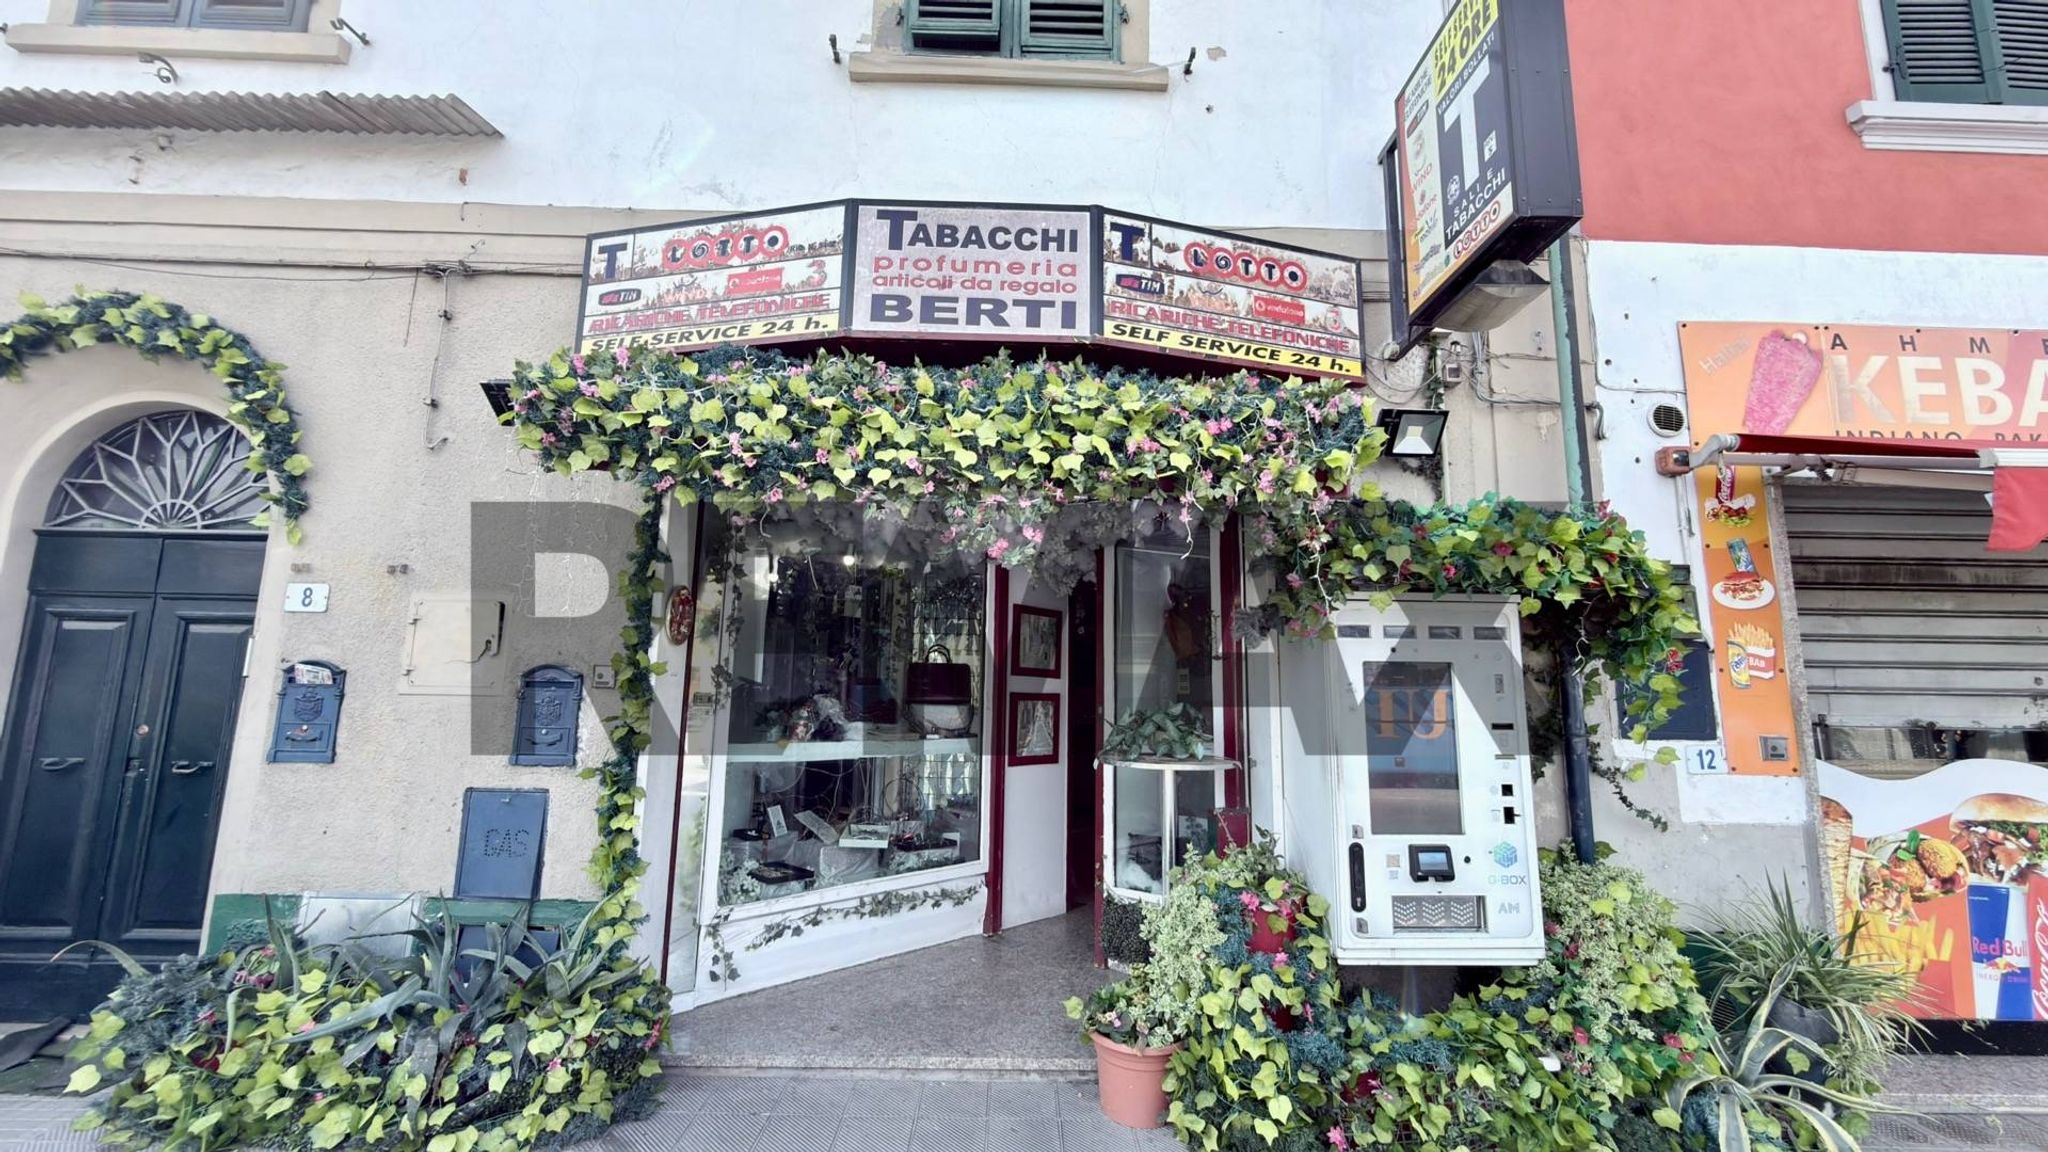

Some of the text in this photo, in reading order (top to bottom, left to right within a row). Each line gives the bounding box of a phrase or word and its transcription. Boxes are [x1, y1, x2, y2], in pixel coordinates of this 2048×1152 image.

[1436, 0, 1491, 97] 24 ORE
[1437, 32, 1494, 114] VALORI BOLLATI
[1443, 53, 1490, 191] T
[1445, 167, 1506, 240] TABACCHI
[1453, 183, 1480, 218] SALI
[1486, 167, 1495, 181] E
[664, 227, 787, 268] LOTTO
[876, 209, 1079, 252] TABACCHI
[1110, 222, 1145, 262] T
[1454, 201, 1501, 260] LOTTO
[598, 243, 628, 279] T
[873, 255, 1077, 277] profumeria
[1184, 243, 1306, 291] LOTTO
[872, 273, 1078, 296] articoli da regalo
[1141, 279, 1161, 293] TIM
[870, 294, 1077, 330] BERTI
[1110, 300, 1220, 329] RICARICHE
[1227, 319, 1350, 353] TELEFONICHE
[591, 336, 643, 351] SELF
[647, 325, 750, 346] SERVICE
[760, 320, 795, 335] 24
[1112, 322, 1352, 374] SELF SERVICE 24 h.
[301, 587, 313, 608] 8
[1696, 749, 1717, 770] 12
[484, 828, 529, 858] GAS
[1972, 936, 2028, 957] Red Bull
